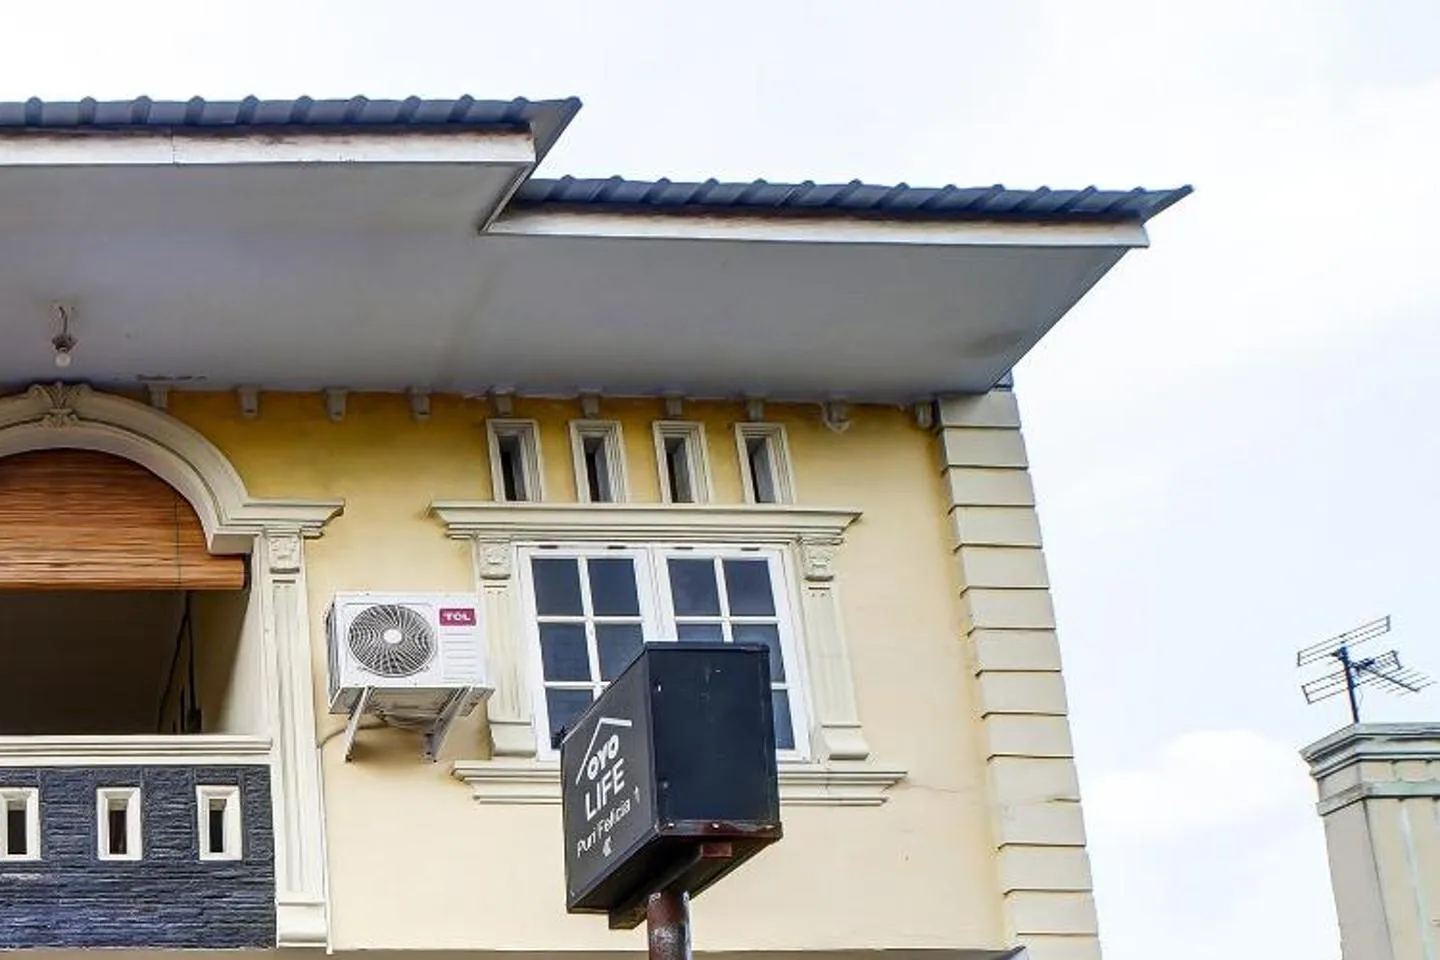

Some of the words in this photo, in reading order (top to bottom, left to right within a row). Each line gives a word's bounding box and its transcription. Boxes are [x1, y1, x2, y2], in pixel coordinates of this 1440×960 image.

[443, 612, 471, 622] TCL
[587, 734, 619, 780] OYO
[584, 758, 625, 821] LIFE
[577, 829, 597, 859] Puri
[597, 799, 631, 838] Felicia
